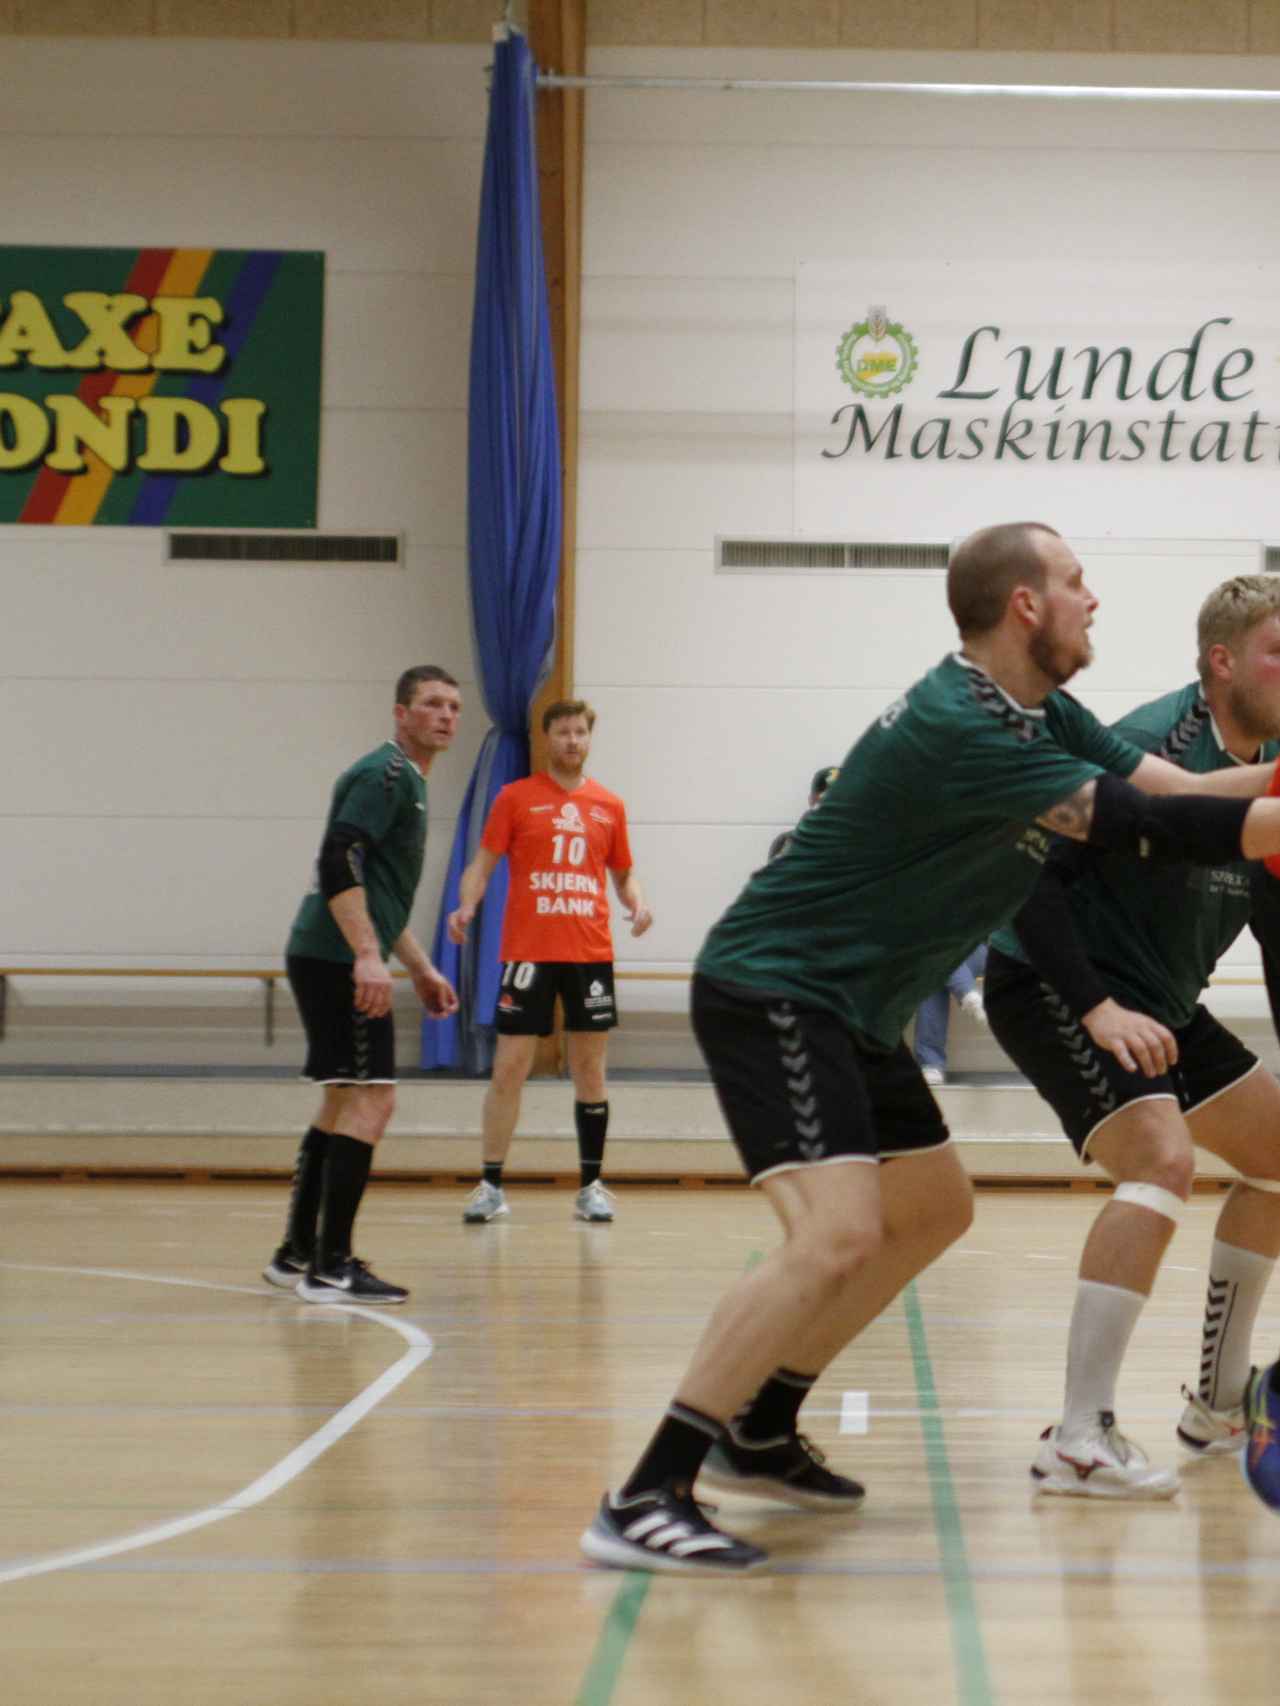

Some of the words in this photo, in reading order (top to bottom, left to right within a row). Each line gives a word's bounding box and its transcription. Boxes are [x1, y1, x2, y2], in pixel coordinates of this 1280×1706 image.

[0, 289, 225, 370] AXE
[936, 316, 1256, 402] Lunde
[552, 834, 587, 866] 10
[529, 871, 599, 896] SKJERN
[535, 896, 597, 917] BANK
[502, 960, 535, 990] 10
